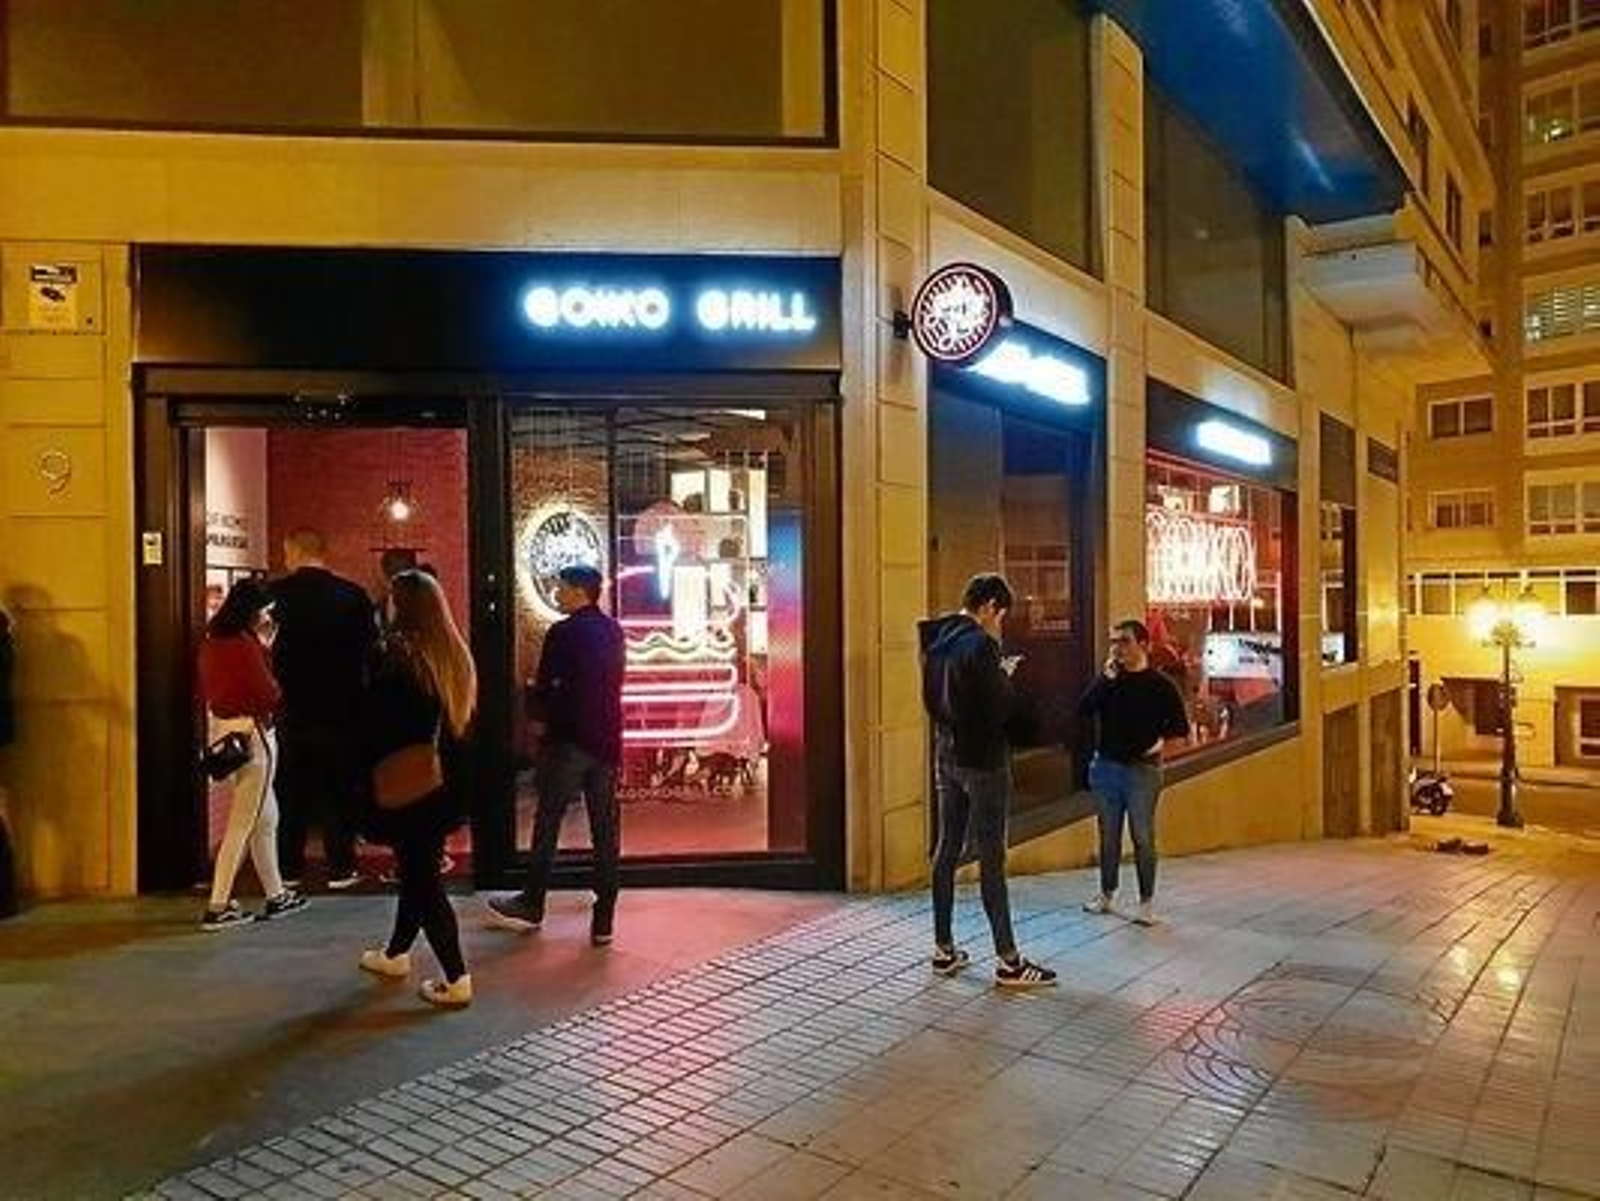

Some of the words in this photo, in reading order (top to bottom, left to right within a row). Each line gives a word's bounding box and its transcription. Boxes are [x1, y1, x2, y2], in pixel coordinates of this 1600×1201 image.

[523, 286, 670, 328] GOIKO
[697, 289, 816, 330] GRILL
[38, 451, 71, 497] 9
